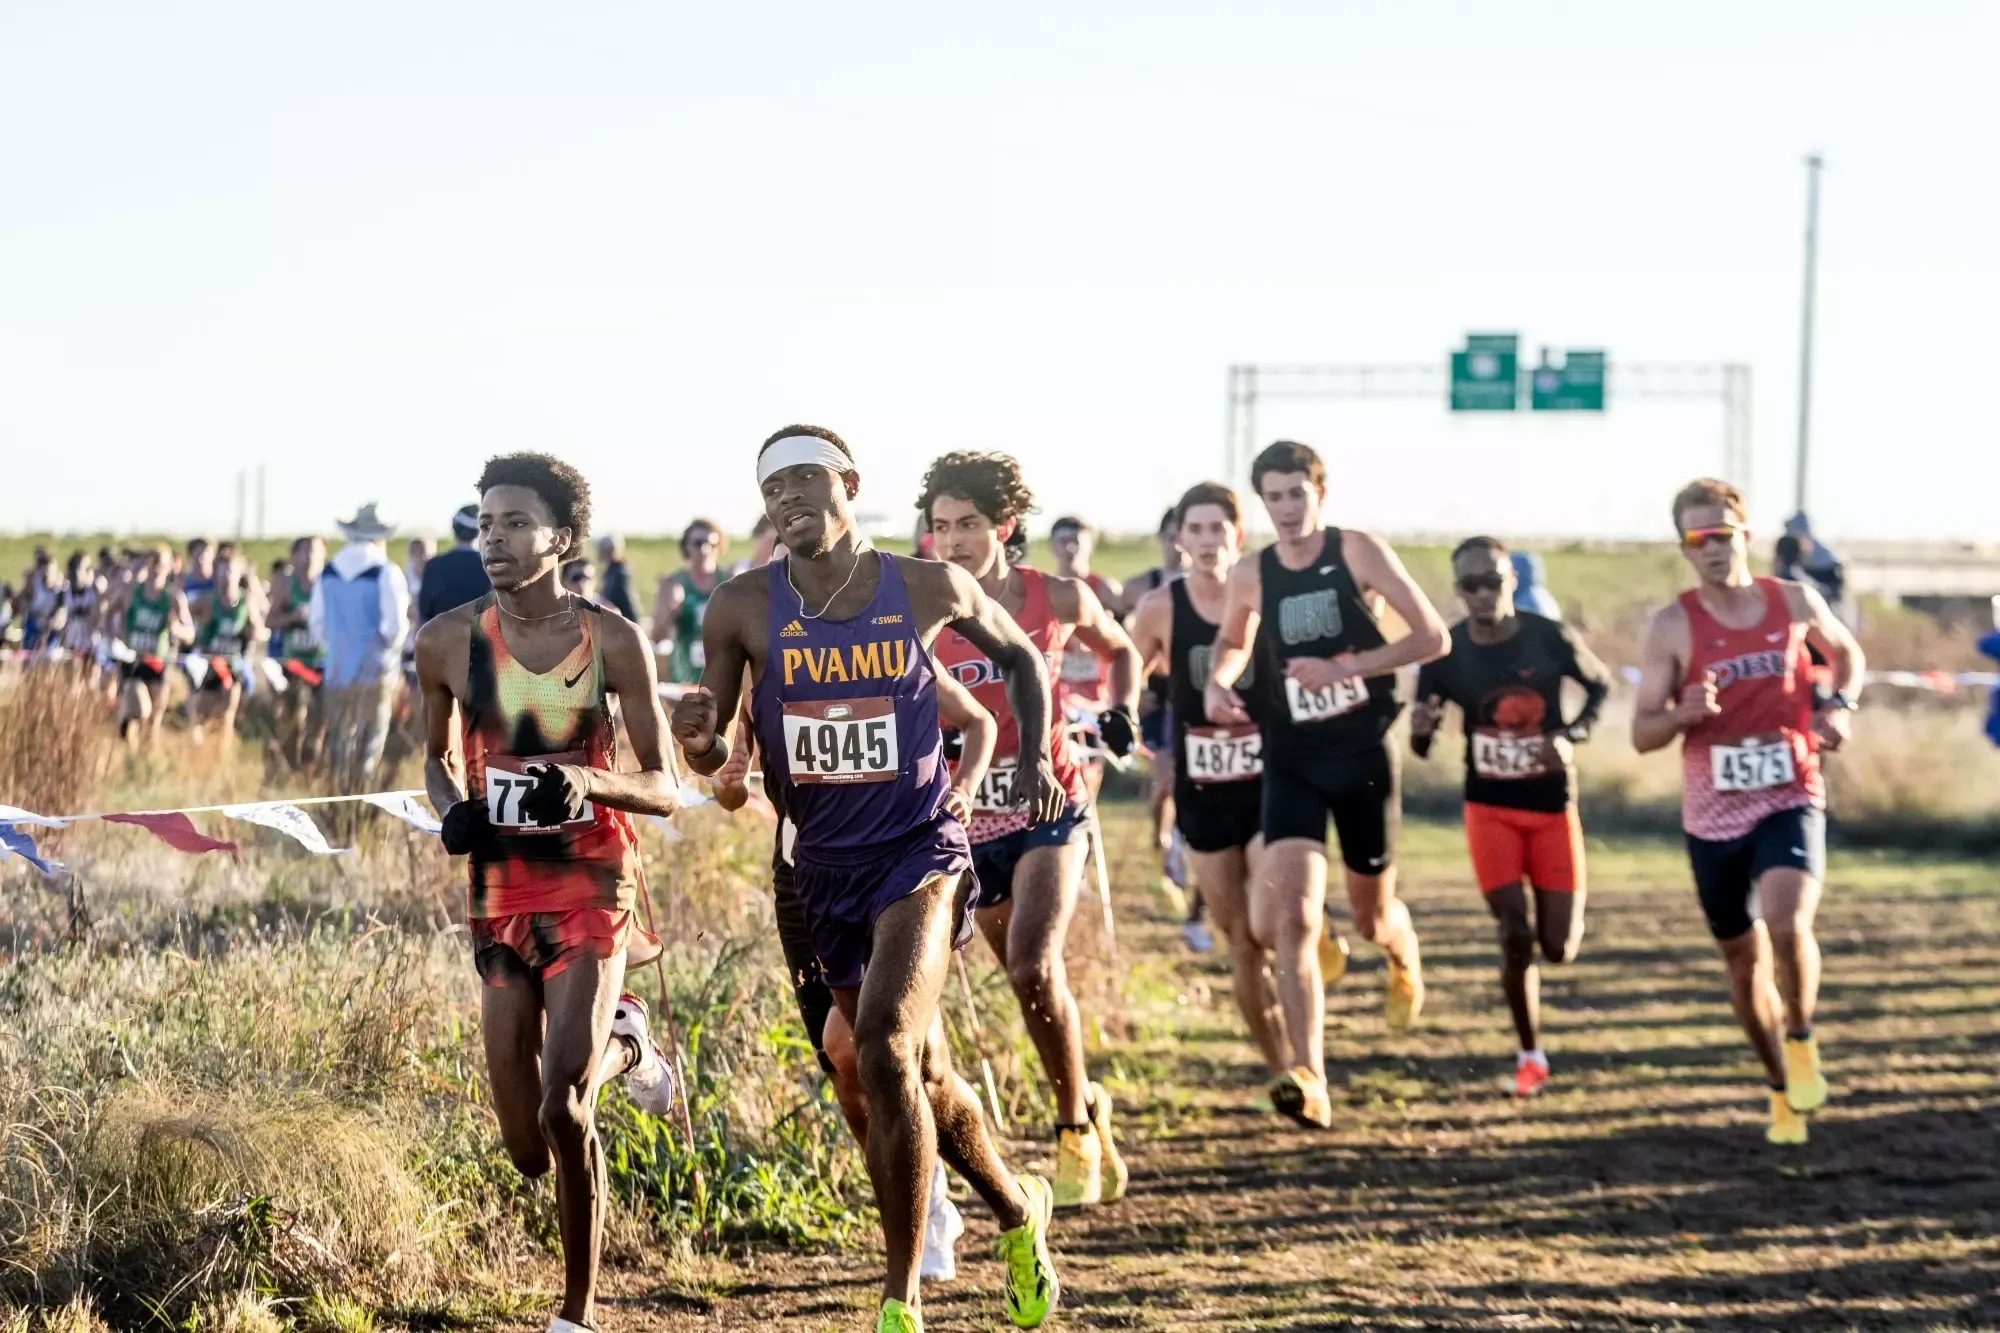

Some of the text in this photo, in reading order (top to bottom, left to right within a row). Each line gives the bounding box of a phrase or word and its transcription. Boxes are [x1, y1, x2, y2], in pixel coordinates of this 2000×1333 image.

[780, 629, 809, 638] adidas
[878, 614, 903, 625] SWAC
[782, 640, 906, 685] PVAMU
[795, 721, 889, 773] 4945
[1195, 741, 1258, 774] 4875
[1722, 748, 1787, 785] 4575
